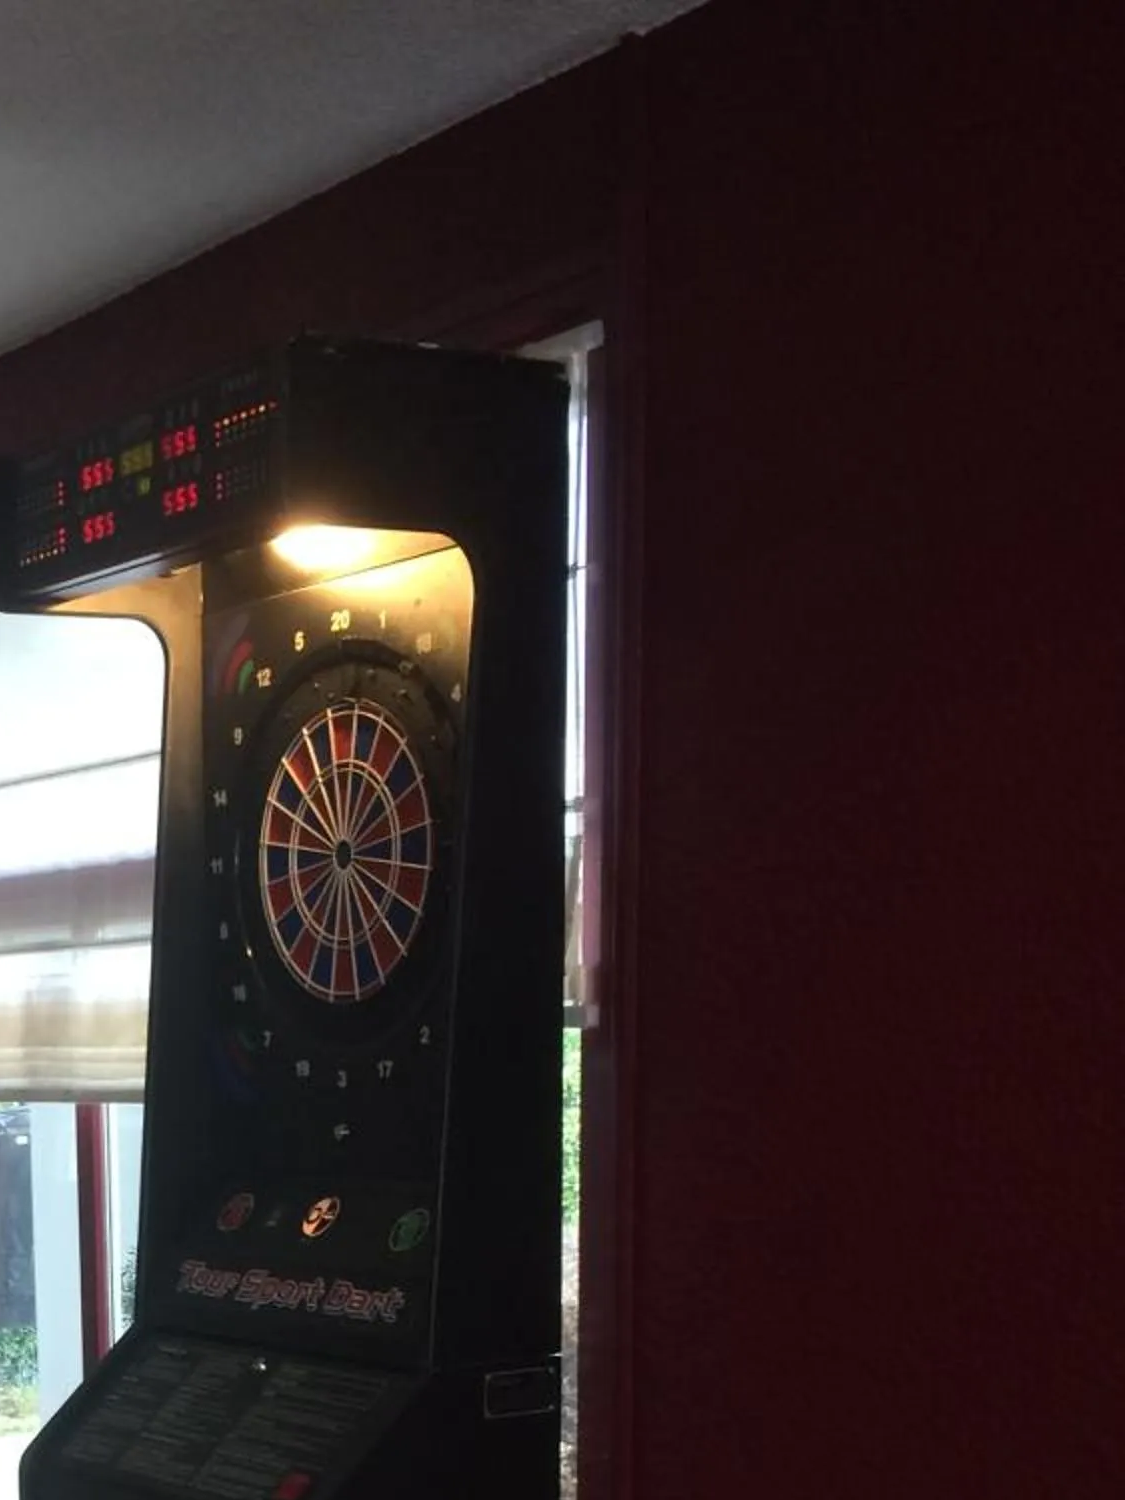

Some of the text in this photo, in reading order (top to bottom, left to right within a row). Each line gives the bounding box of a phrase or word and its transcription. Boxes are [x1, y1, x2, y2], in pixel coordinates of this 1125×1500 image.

[331, 609, 350, 631] 20
[379, 609, 387, 629] 1
[294, 630, 305, 651] 5
[256, 667, 272, 688] 12
[233, 727, 243, 746] 9
[210, 857, 224, 875] 11
[419, 1025, 431, 1044] 2
[337, 1069, 348, 1088] 3
[377, 1060, 394, 1079] 17
[177, 1259, 406, 1323] Tour Sport Dart
